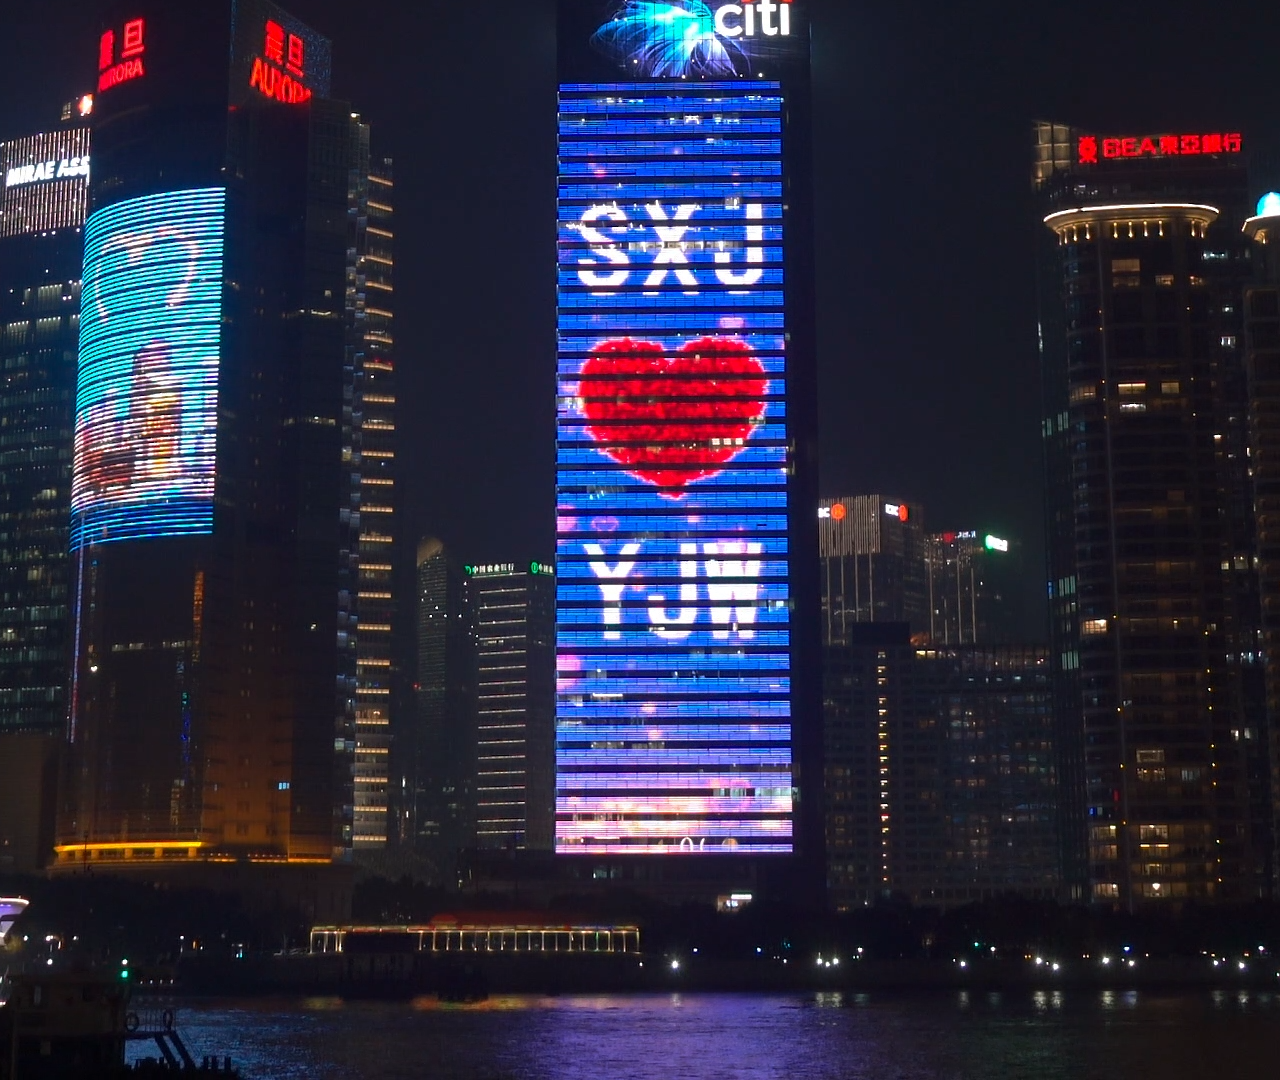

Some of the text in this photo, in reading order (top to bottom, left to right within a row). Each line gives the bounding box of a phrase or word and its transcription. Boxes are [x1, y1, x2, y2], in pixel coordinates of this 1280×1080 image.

[99, 58, 145, 93] RORA
[1102, 136, 1158, 159] BEA
[6, 160, 56, 187] MIRAE
[577, 202, 764, 296] SXJ
[583, 542, 763, 641] YJW
